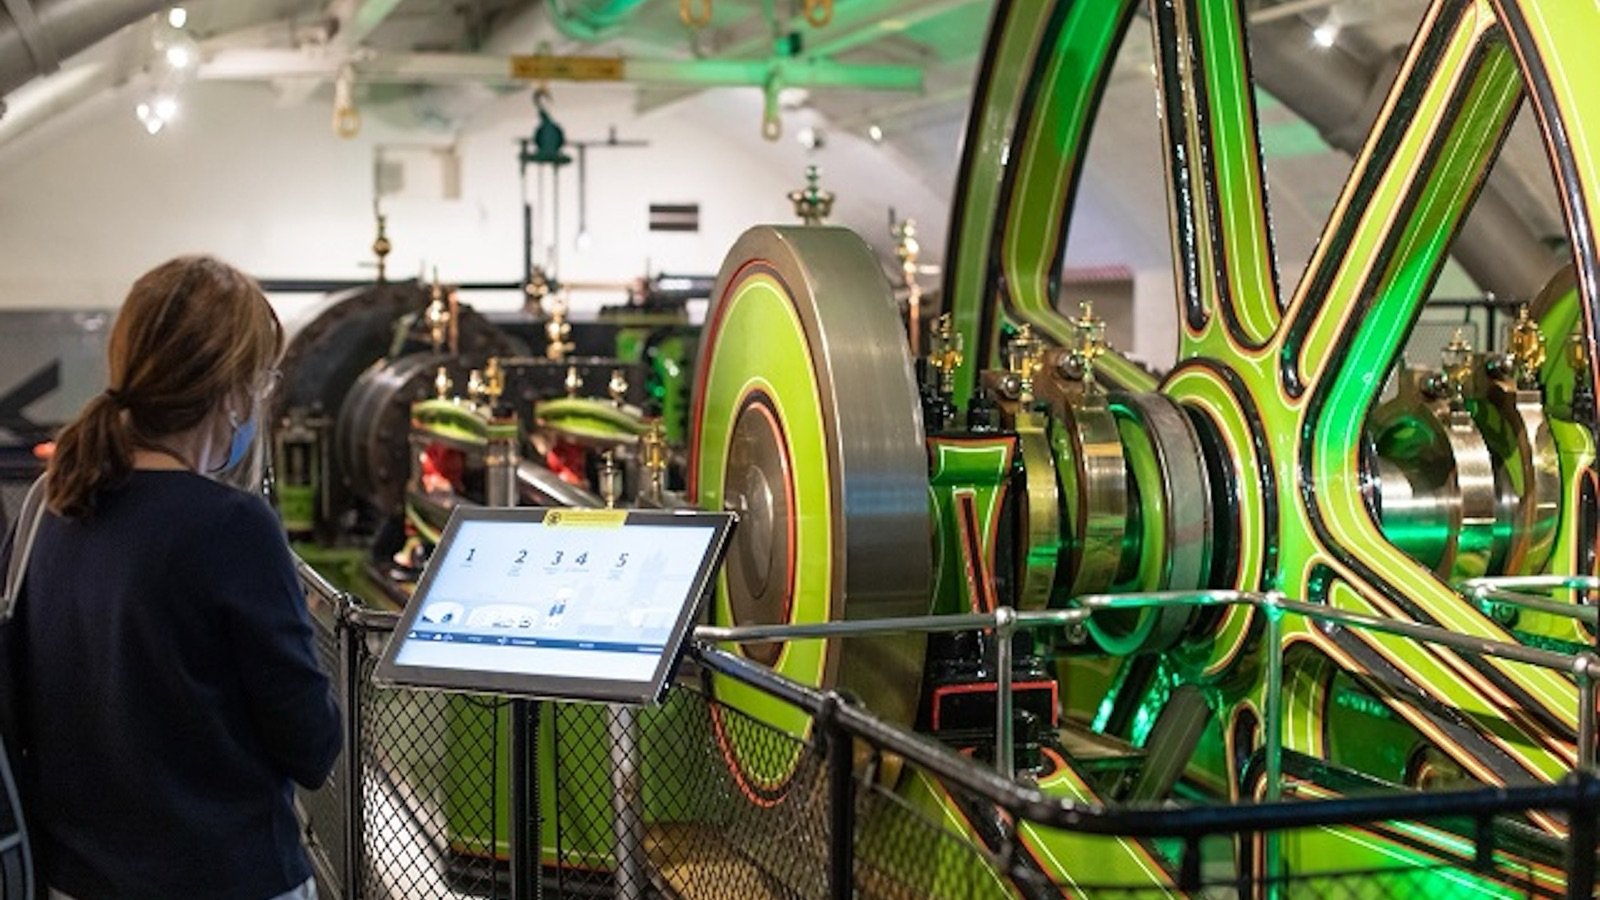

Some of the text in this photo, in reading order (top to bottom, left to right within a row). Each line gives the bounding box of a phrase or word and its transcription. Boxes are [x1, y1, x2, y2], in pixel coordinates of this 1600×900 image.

[466, 548, 629, 568] 1 2 3 4 5
